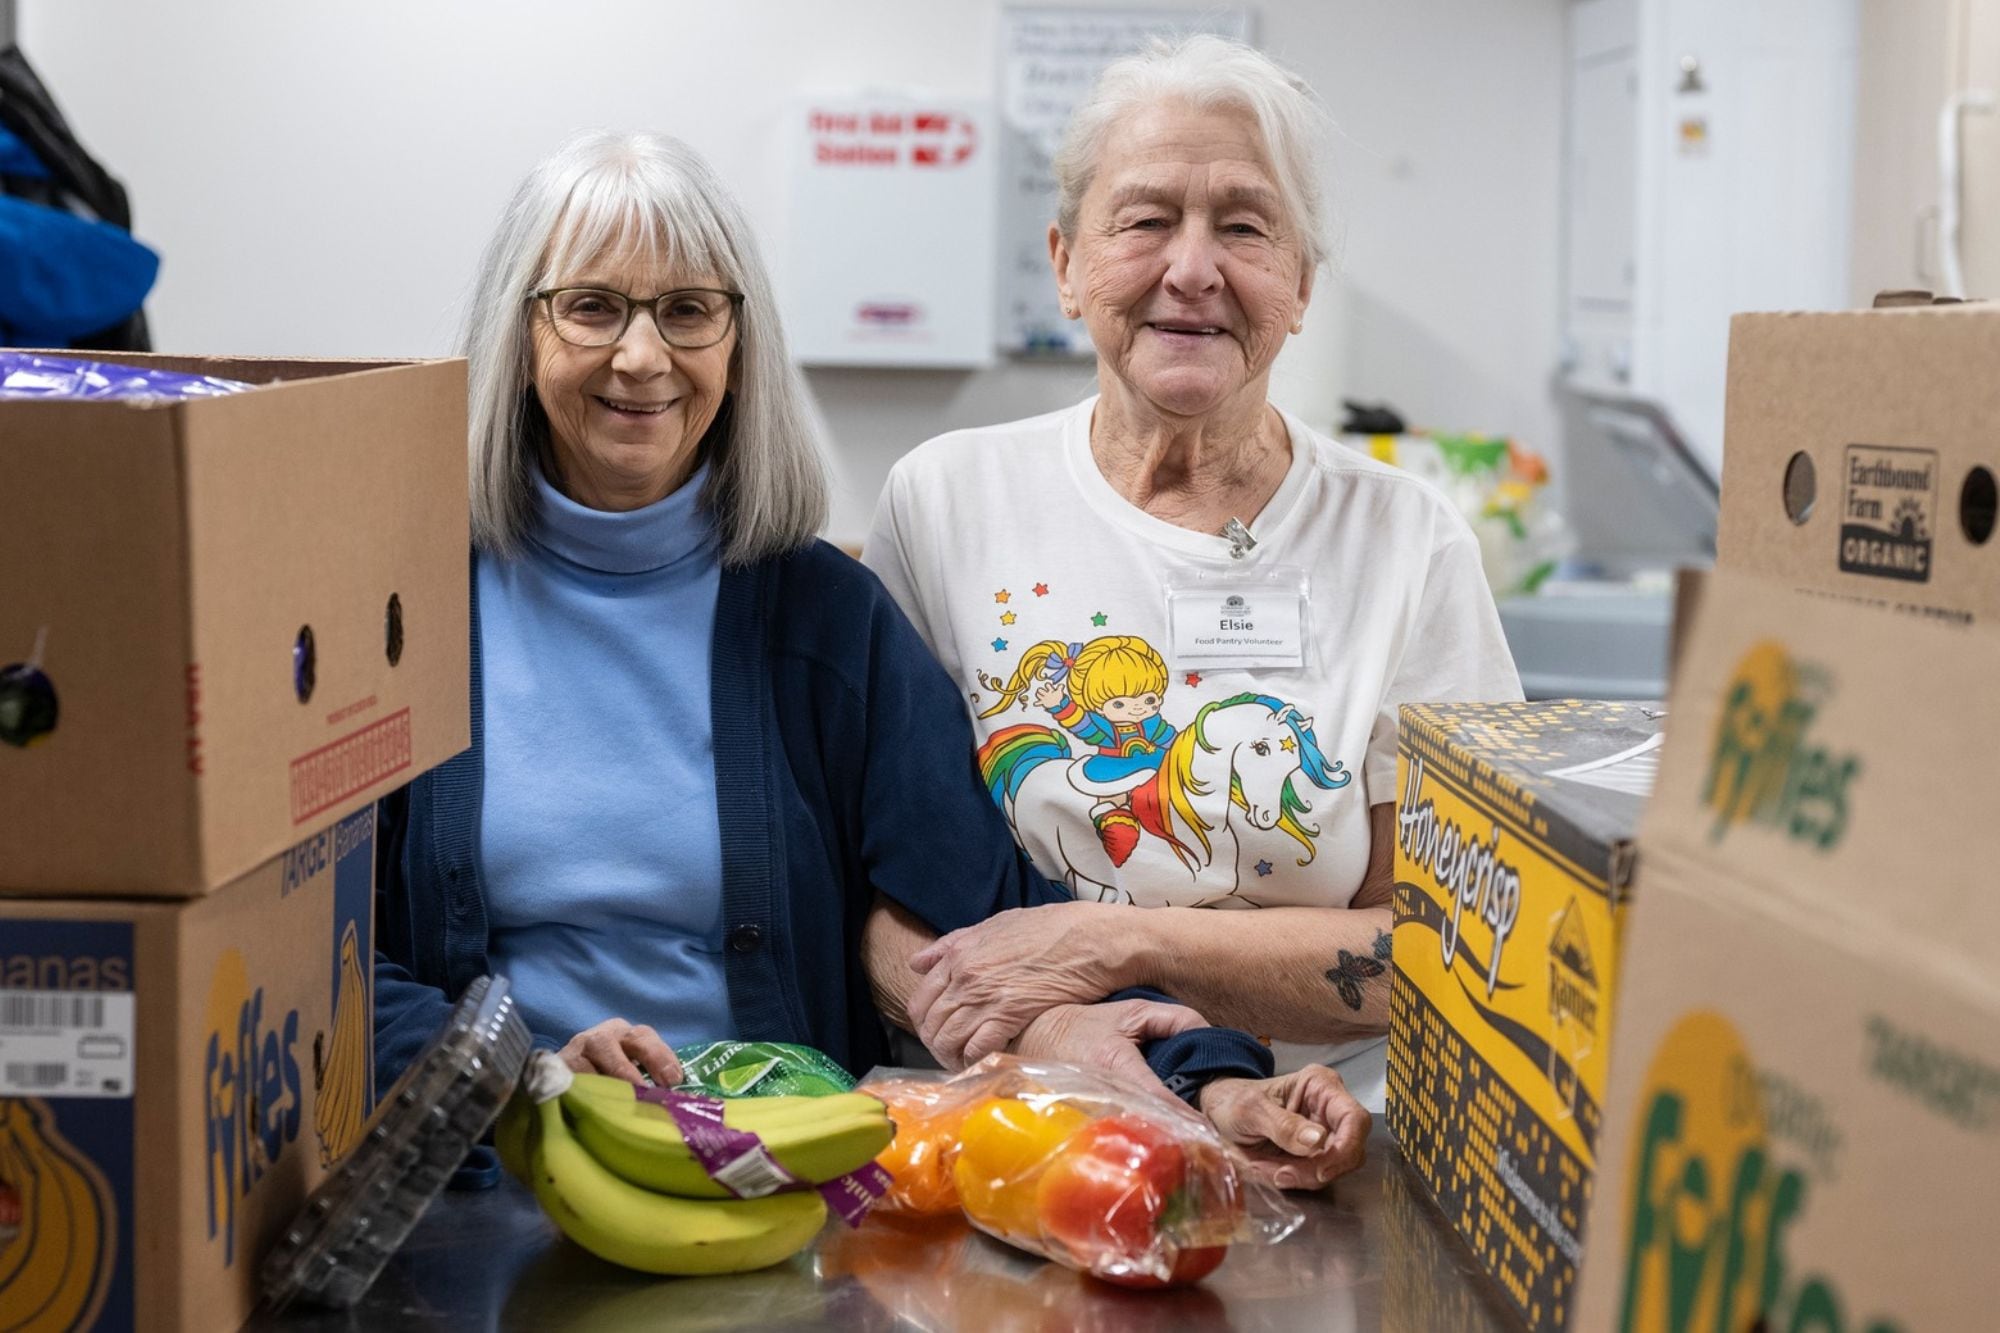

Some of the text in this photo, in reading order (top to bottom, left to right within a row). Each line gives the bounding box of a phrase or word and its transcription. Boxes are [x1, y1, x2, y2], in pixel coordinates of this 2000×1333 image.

[1849, 456, 1931, 492] Earthbound
[1847, 488, 1883, 520] Farm
[1842, 537, 1928, 573] ORGANIC
[1195, 637, 1283, 646] Food Pantry Volunteer
[1219, 619, 1254, 631] Elsie
[1399, 756, 1521, 998] Honeycrisp
[0, 954, 129, 991] anas
